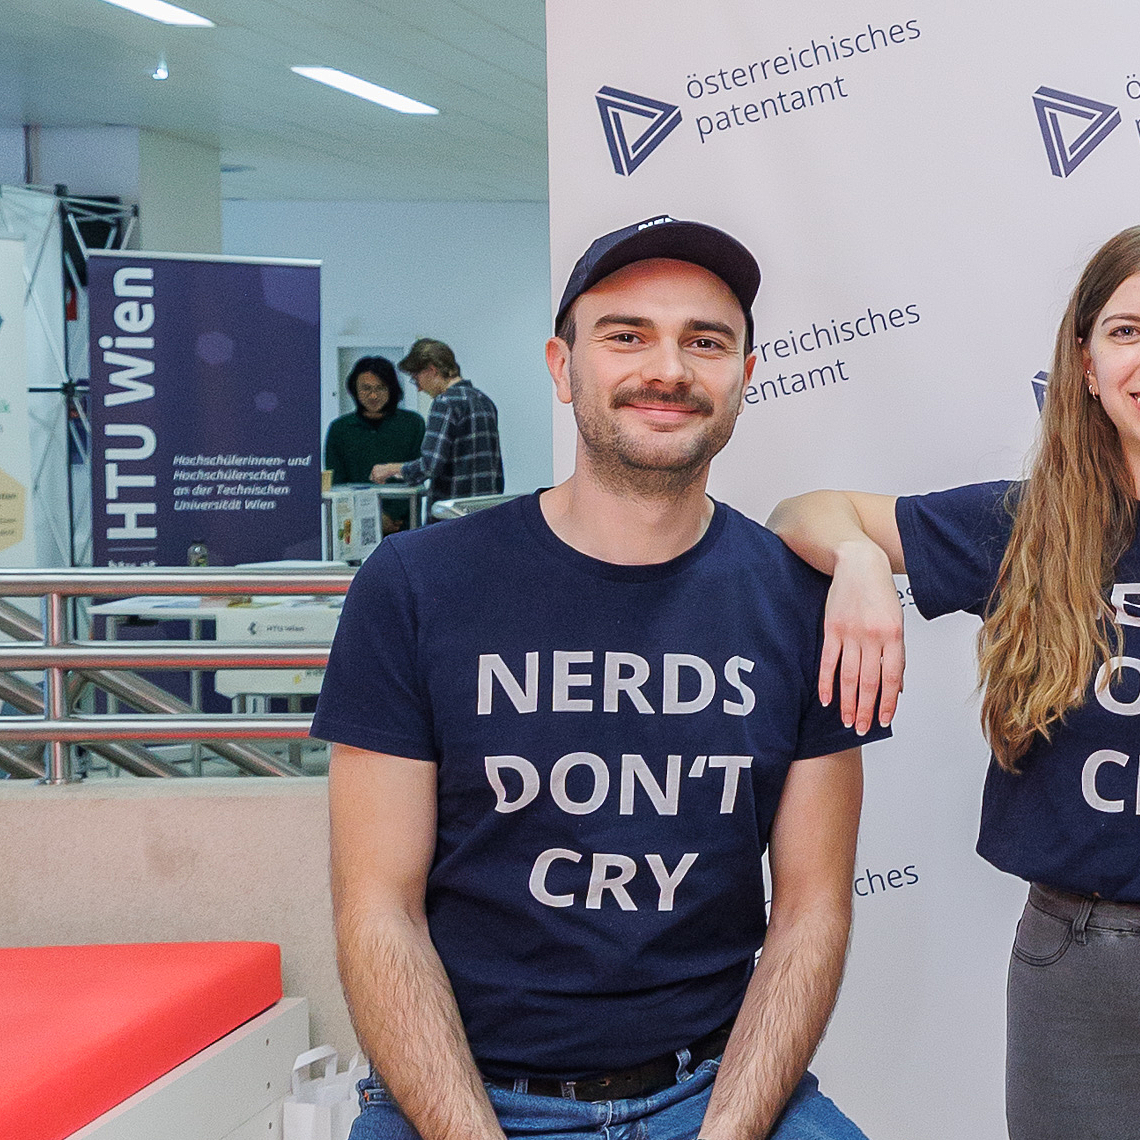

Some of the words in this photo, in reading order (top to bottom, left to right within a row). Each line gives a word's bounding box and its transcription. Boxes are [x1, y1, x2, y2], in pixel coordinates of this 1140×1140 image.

[686, 19, 921, 99] österreichisches
[695, 75, 849, 144] patentamt
[98, 266, 155, 407] Wien
[752, 304, 920, 362] reichisches
[744, 359, 849, 404] entamt
[104, 424, 157, 540] HTU
[173, 469, 286, 481] Hochschülerschaft
[173, 486, 190, 496] an
[191, 484, 213, 496] der
[216, 484, 290, 496] Technischen
[287, 455, 312, 466] und
[173, 499, 241, 511] Universität
[244, 499, 276, 511] Wien
[477, 650, 756, 717] NERDS
[484, 751, 754, 816] DON'T
[528, 847, 700, 912] CRY
